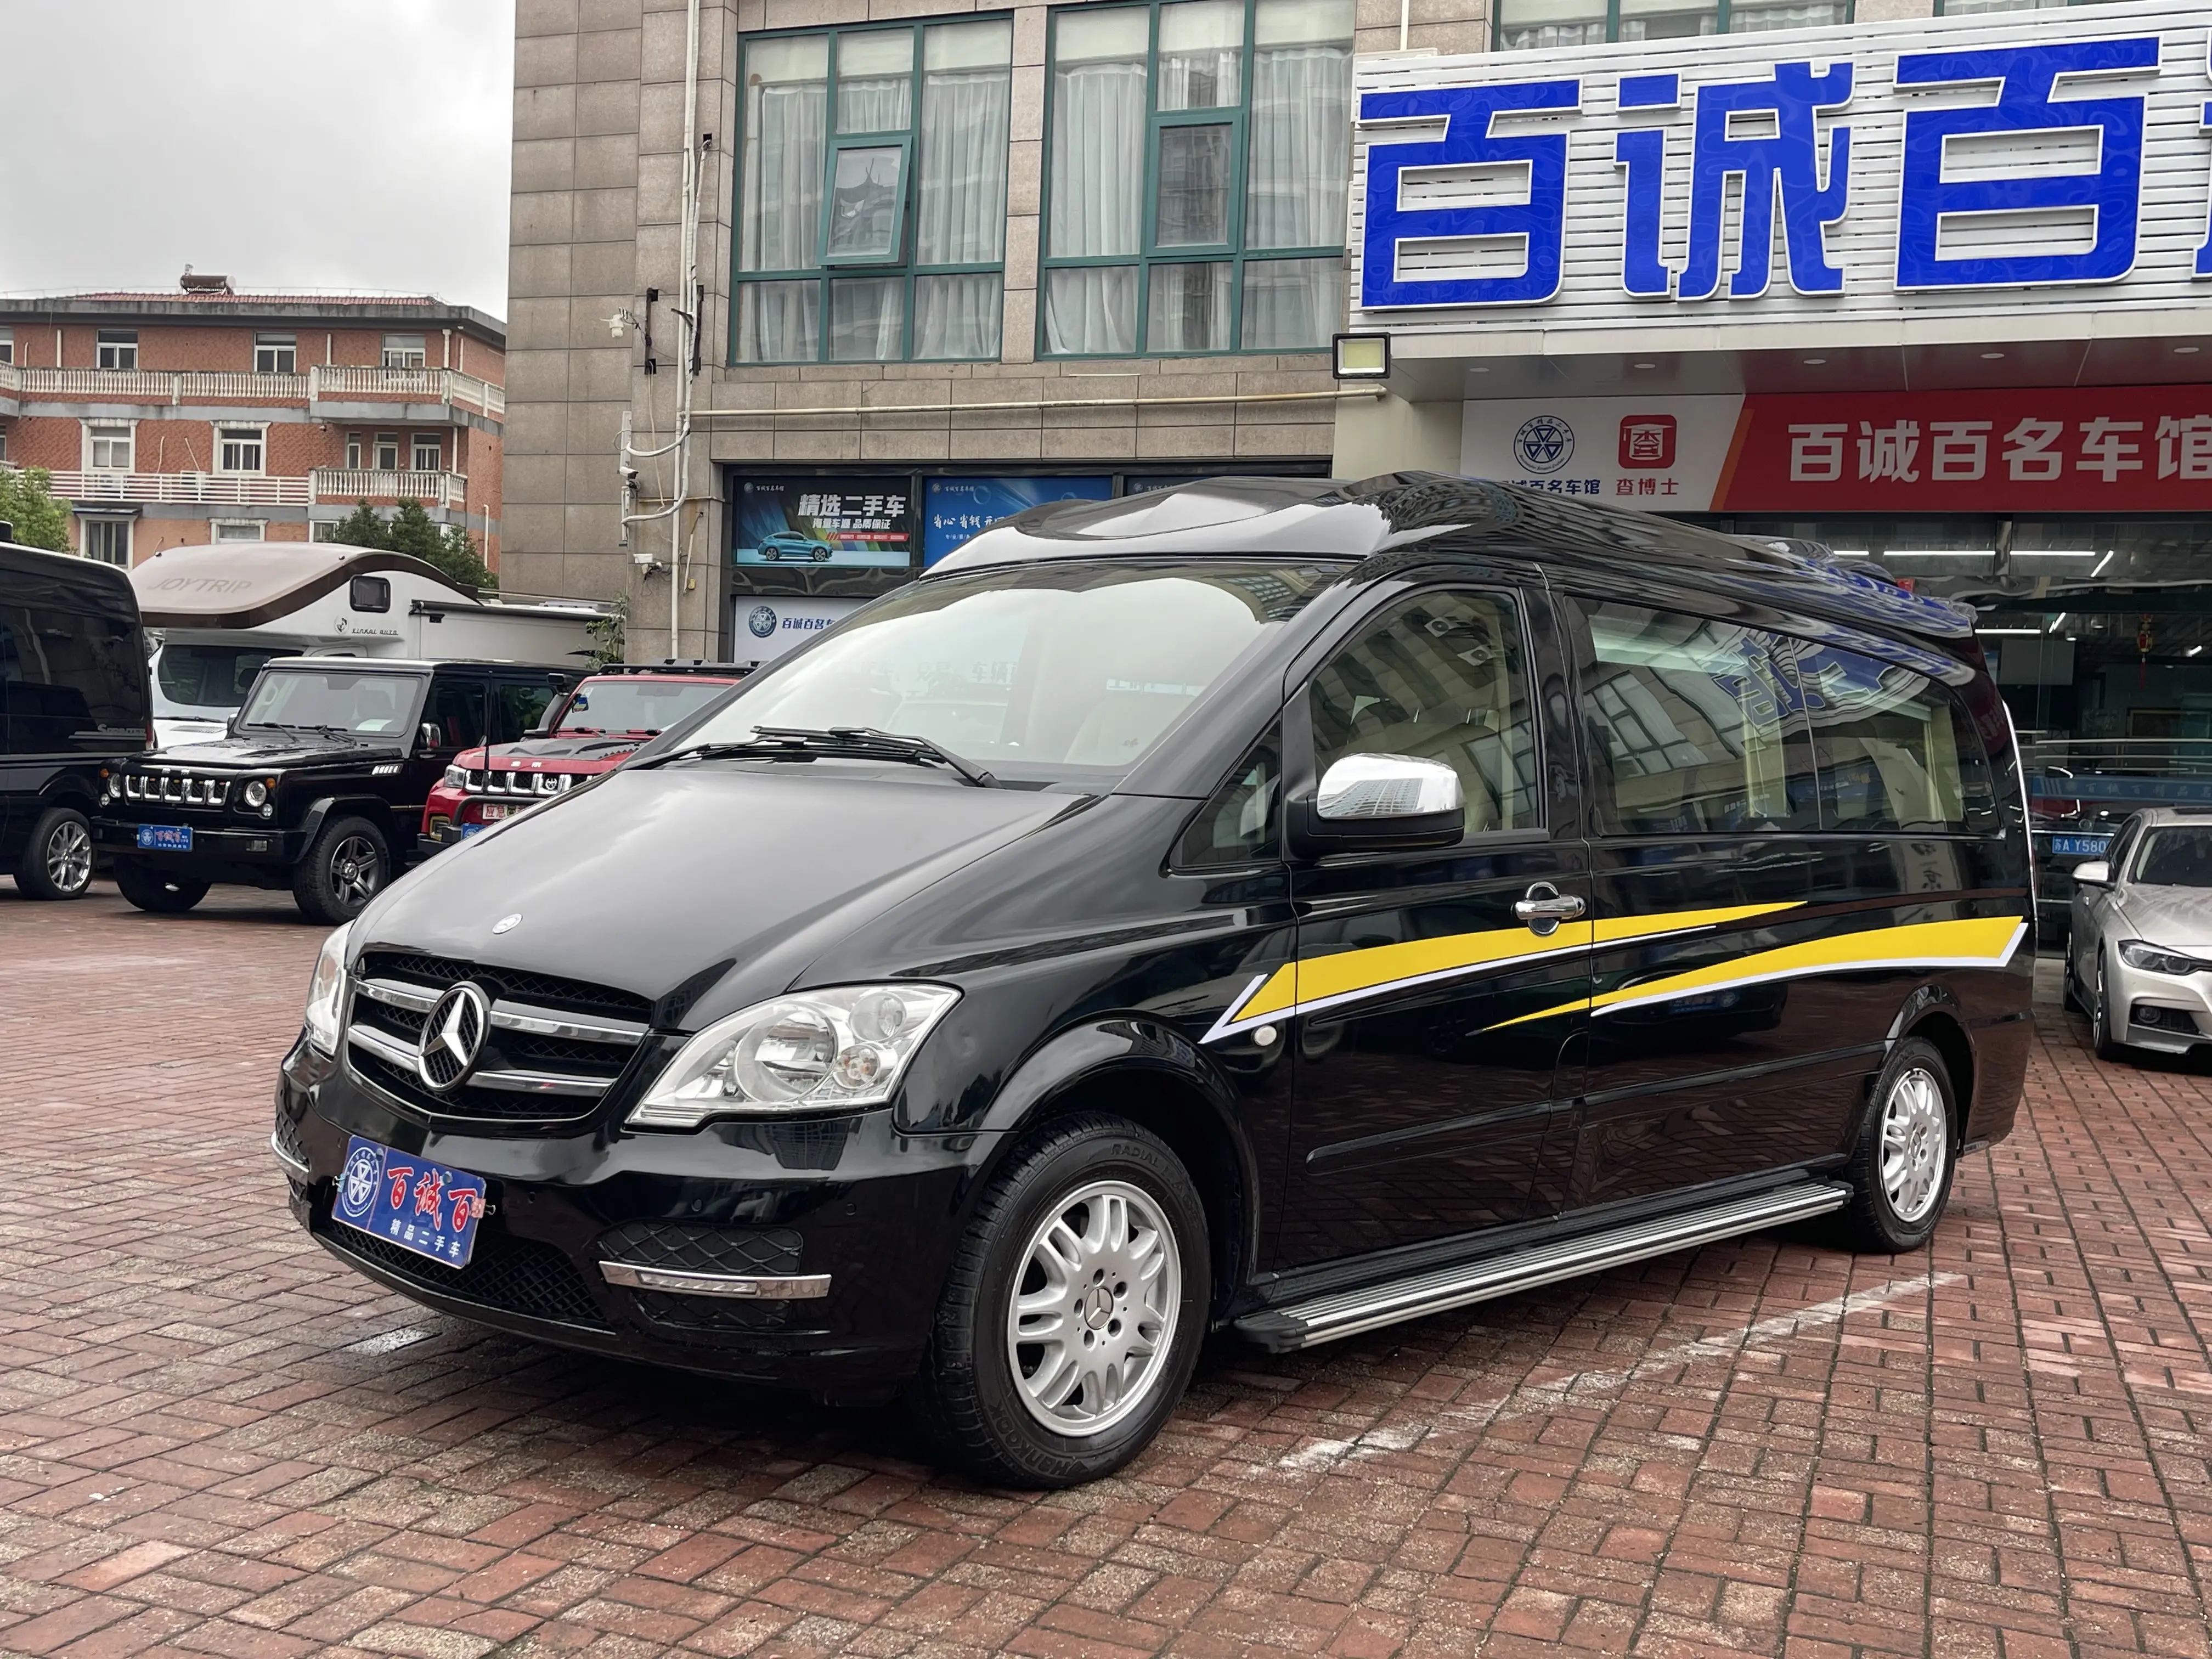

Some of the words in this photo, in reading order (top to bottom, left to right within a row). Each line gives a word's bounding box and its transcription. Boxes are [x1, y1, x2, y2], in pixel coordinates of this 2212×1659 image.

[1357, 27, 2212, 311] 百诚百
[1788, 415, 2212, 483] 百诚百名车馆
[1501, 479, 1600, 495] 百名车馆
[1616, 478, 1679, 496] 查博士
[798, 494, 906, 517] 精选二手车
[853, 518, 891, 530] 品质保证
[934, 514, 956, 529] 省心
[960, 514, 981, 529] 省钱
[146, 578, 252, 594] JOYTRIP
[390, 1218, 461, 1258] 精品二手车
